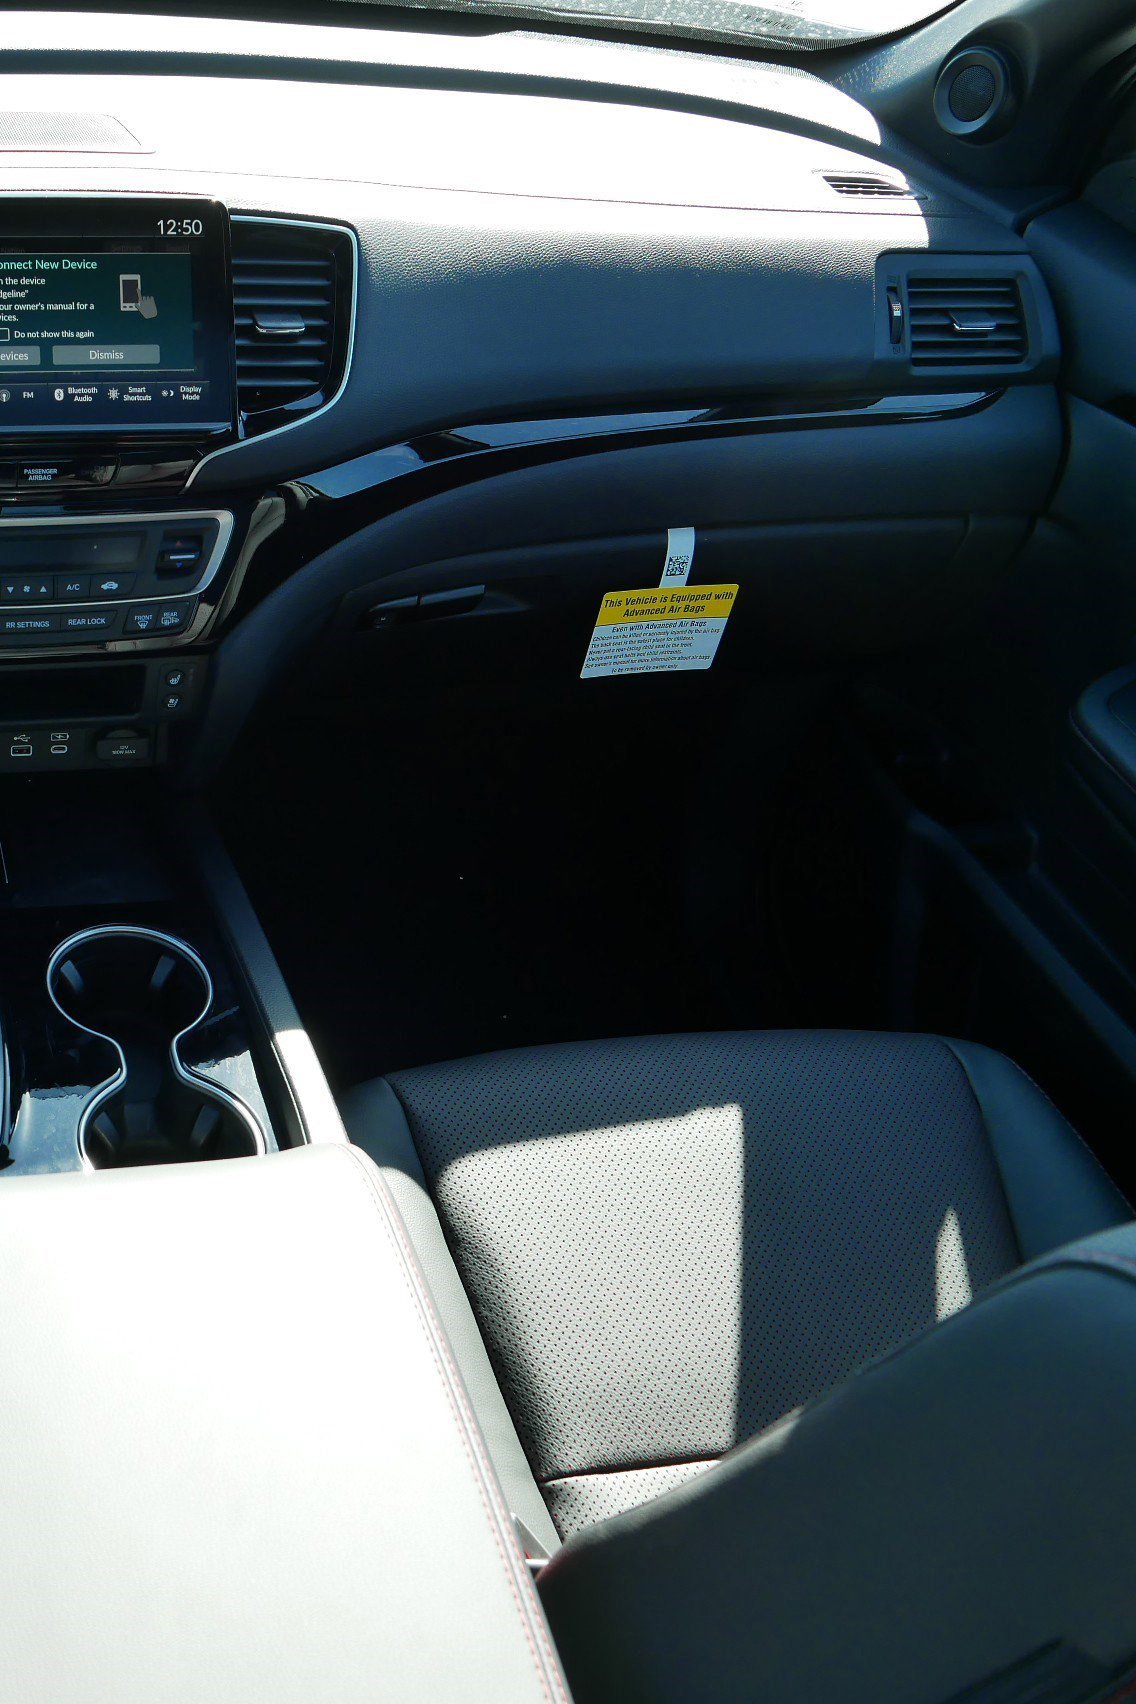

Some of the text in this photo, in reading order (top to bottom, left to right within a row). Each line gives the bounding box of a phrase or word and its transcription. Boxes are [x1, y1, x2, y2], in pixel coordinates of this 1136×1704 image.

[157, 220, 202, 235] 12:50
[36, 260, 59, 270] New
[62, 258, 97, 270] Device
[5, 277, 18, 285] the
[20, 277, 46, 285] device
[14, 302, 44, 310] owner's
[46, 302, 74, 310] manual
[76, 302, 88, 310] for
[76, 330, 95, 339] again
[89, 350, 124, 360] Dismiss
[604, 591, 734, 608] This Vehicle is Equipped with
[623, 604, 706, 618] Advanced Air Bags
[16, 620, 50, 628] SETTINGS
[644, 621, 678, 630] Advanced
